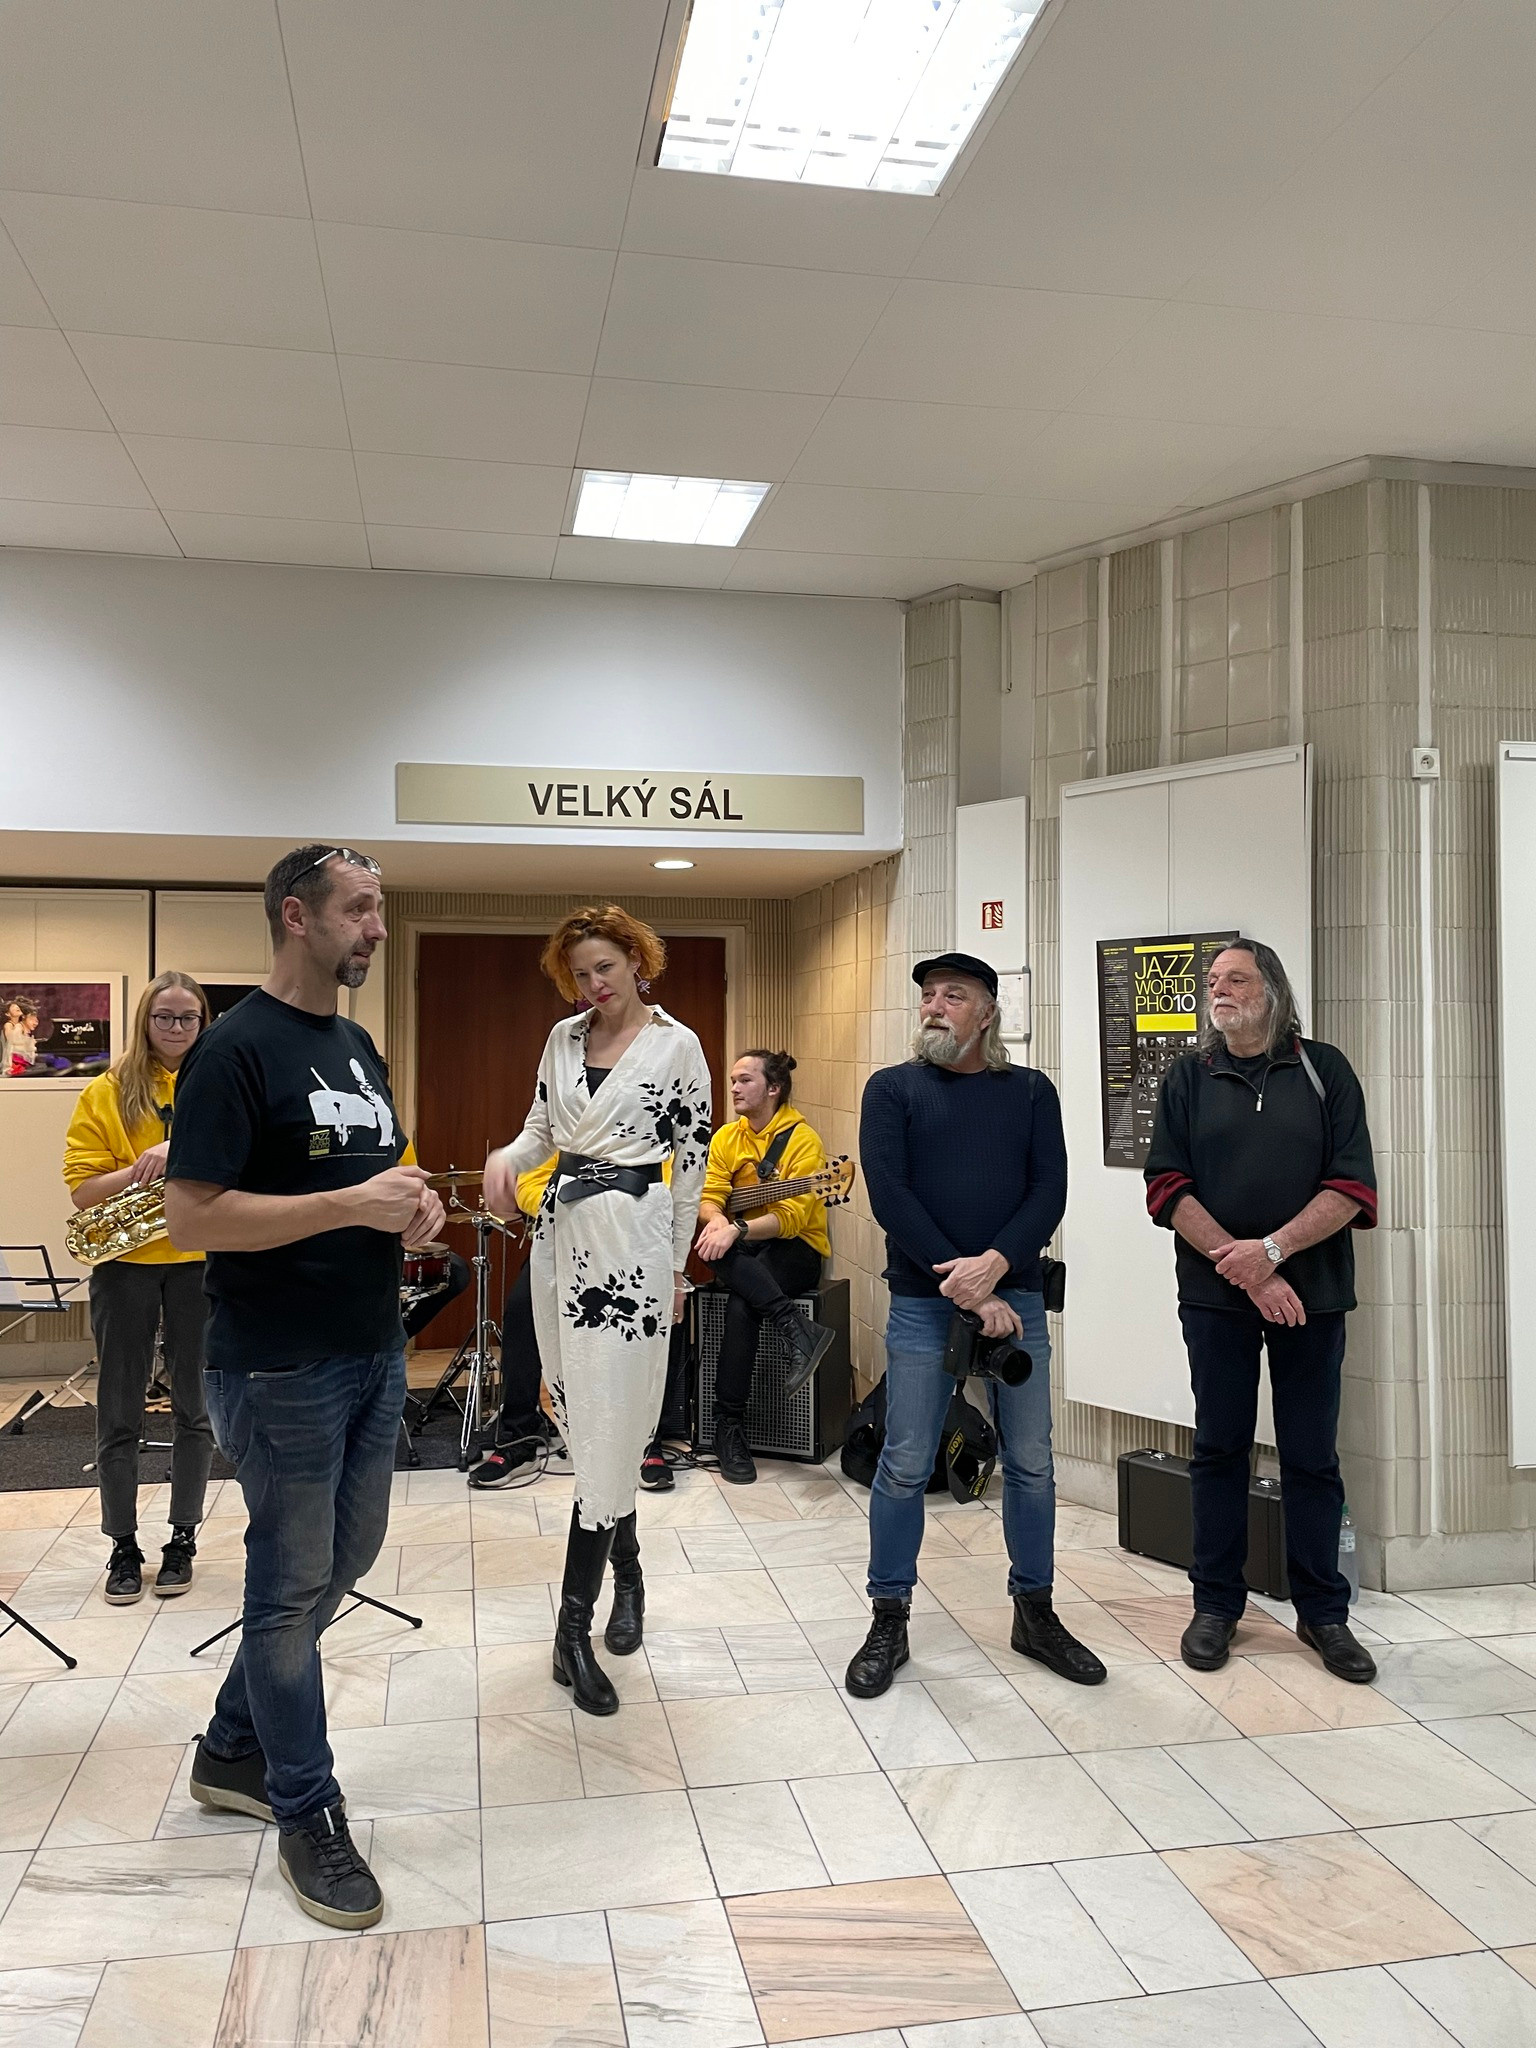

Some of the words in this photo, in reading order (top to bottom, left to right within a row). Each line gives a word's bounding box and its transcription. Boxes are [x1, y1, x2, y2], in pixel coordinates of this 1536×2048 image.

[528, 779, 657, 818] VELKÝ
[670, 780, 743, 820] SÁL
[1134, 954, 1196, 980] JAZZ
[1135, 978, 1196, 995] WORLD
